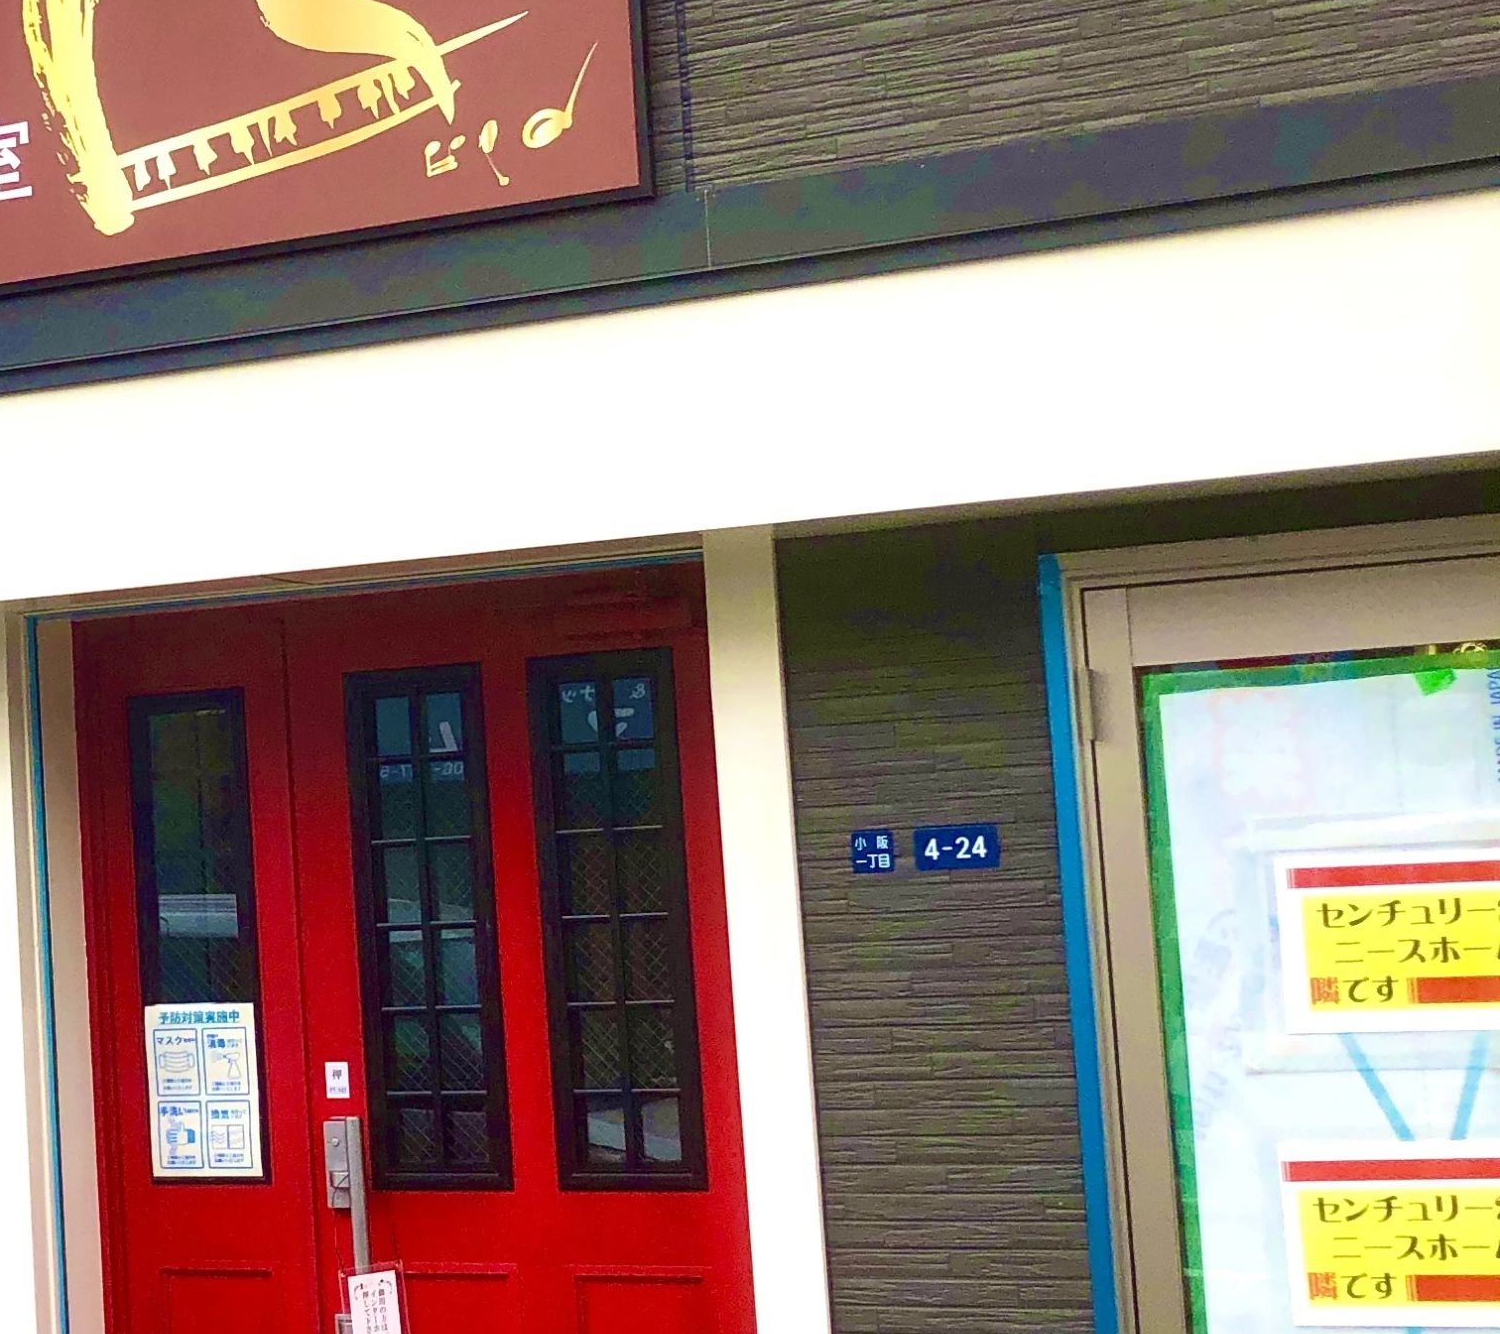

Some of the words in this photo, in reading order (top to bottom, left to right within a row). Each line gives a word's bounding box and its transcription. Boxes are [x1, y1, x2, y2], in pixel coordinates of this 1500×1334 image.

[856, 853, 890, 869] 一丁目
[924, 835, 988, 860] 4-24
[1316, 897, 1500, 928] センチュリー
[1335, 936, 1500, 964] ニースホー
[1312, 1195, 1500, 1223] センチュリー
[1333, 1233, 1500, 1260] ニースホー
